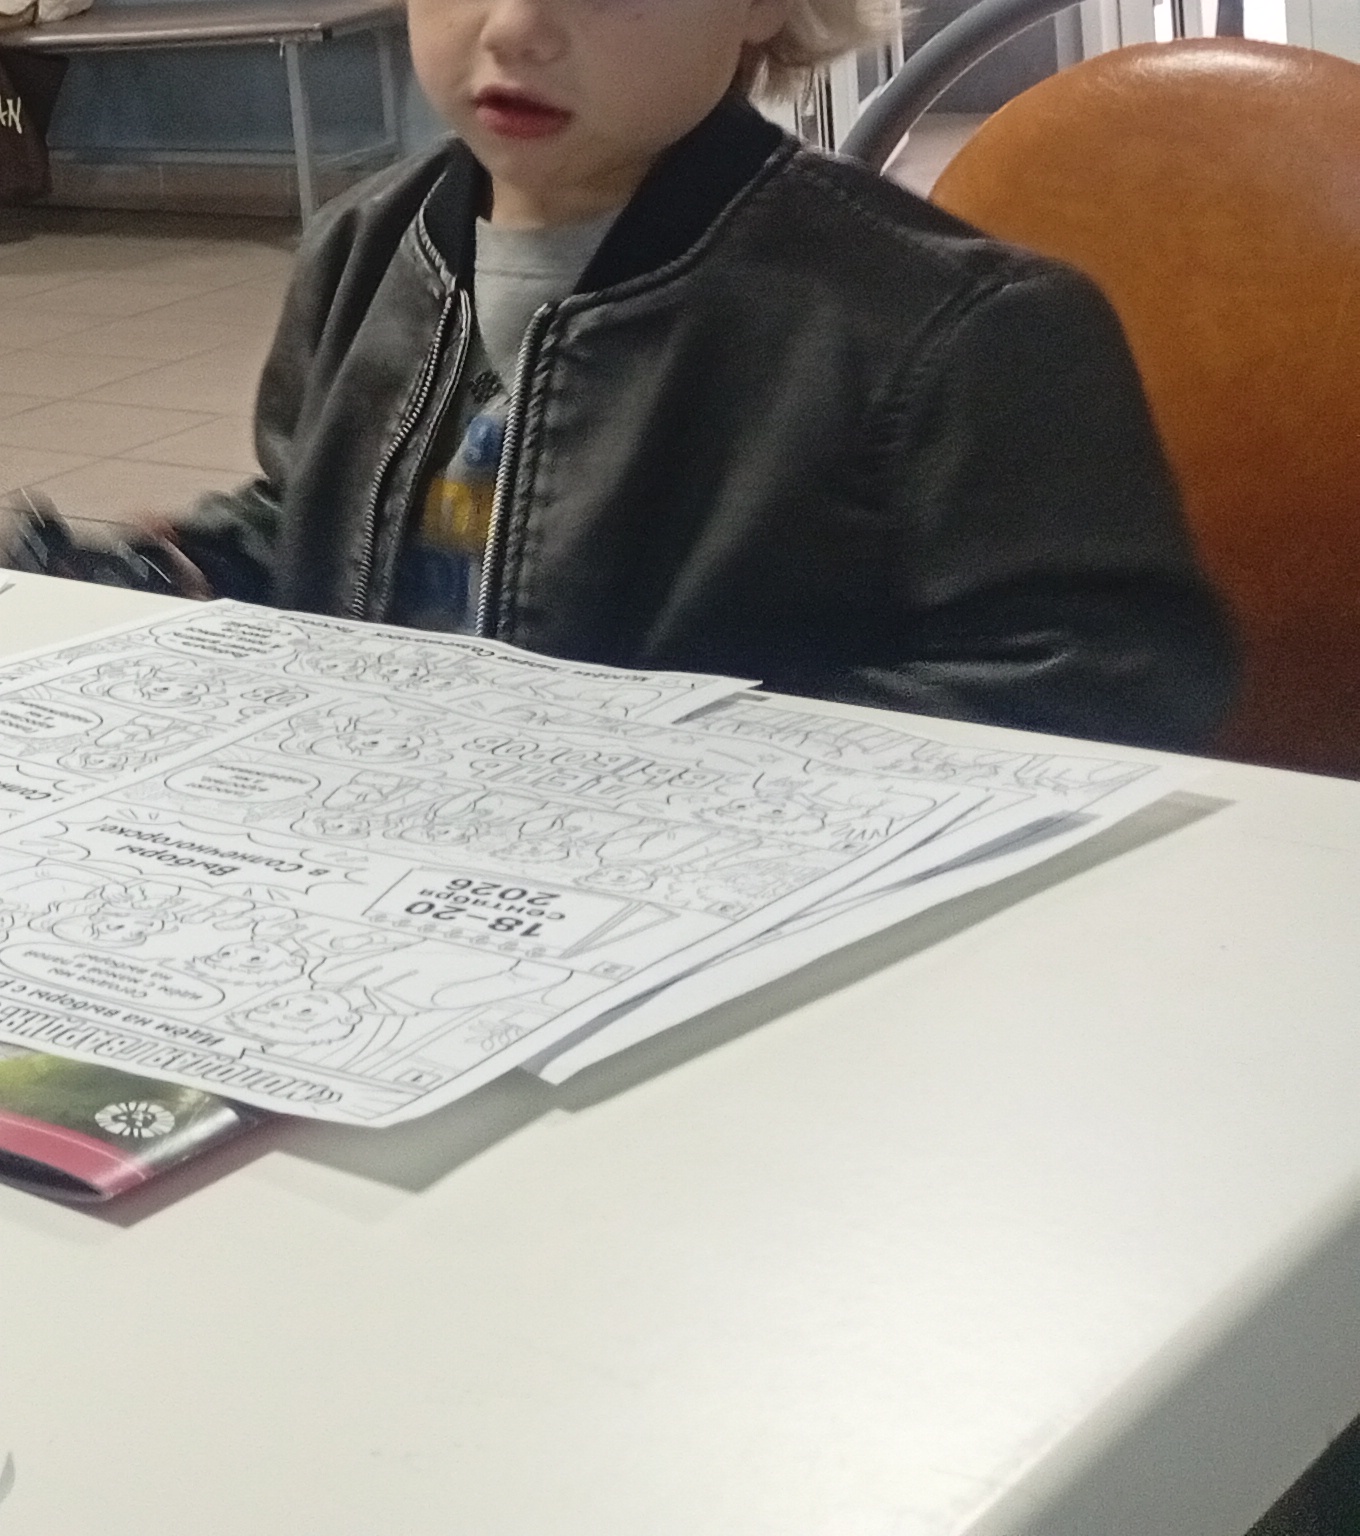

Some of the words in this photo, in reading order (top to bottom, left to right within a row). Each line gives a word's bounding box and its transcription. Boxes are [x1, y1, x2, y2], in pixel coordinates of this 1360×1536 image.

[87, 822, 305, 874] Солнечногорске!
[116, 843, 240, 877] Выборы
[447, 876, 562, 907] 2026
[35, 989, 119, 1020] выборы
[122, 1011, 150, 1028] на
[156, 1020, 223, 1047] Идём
